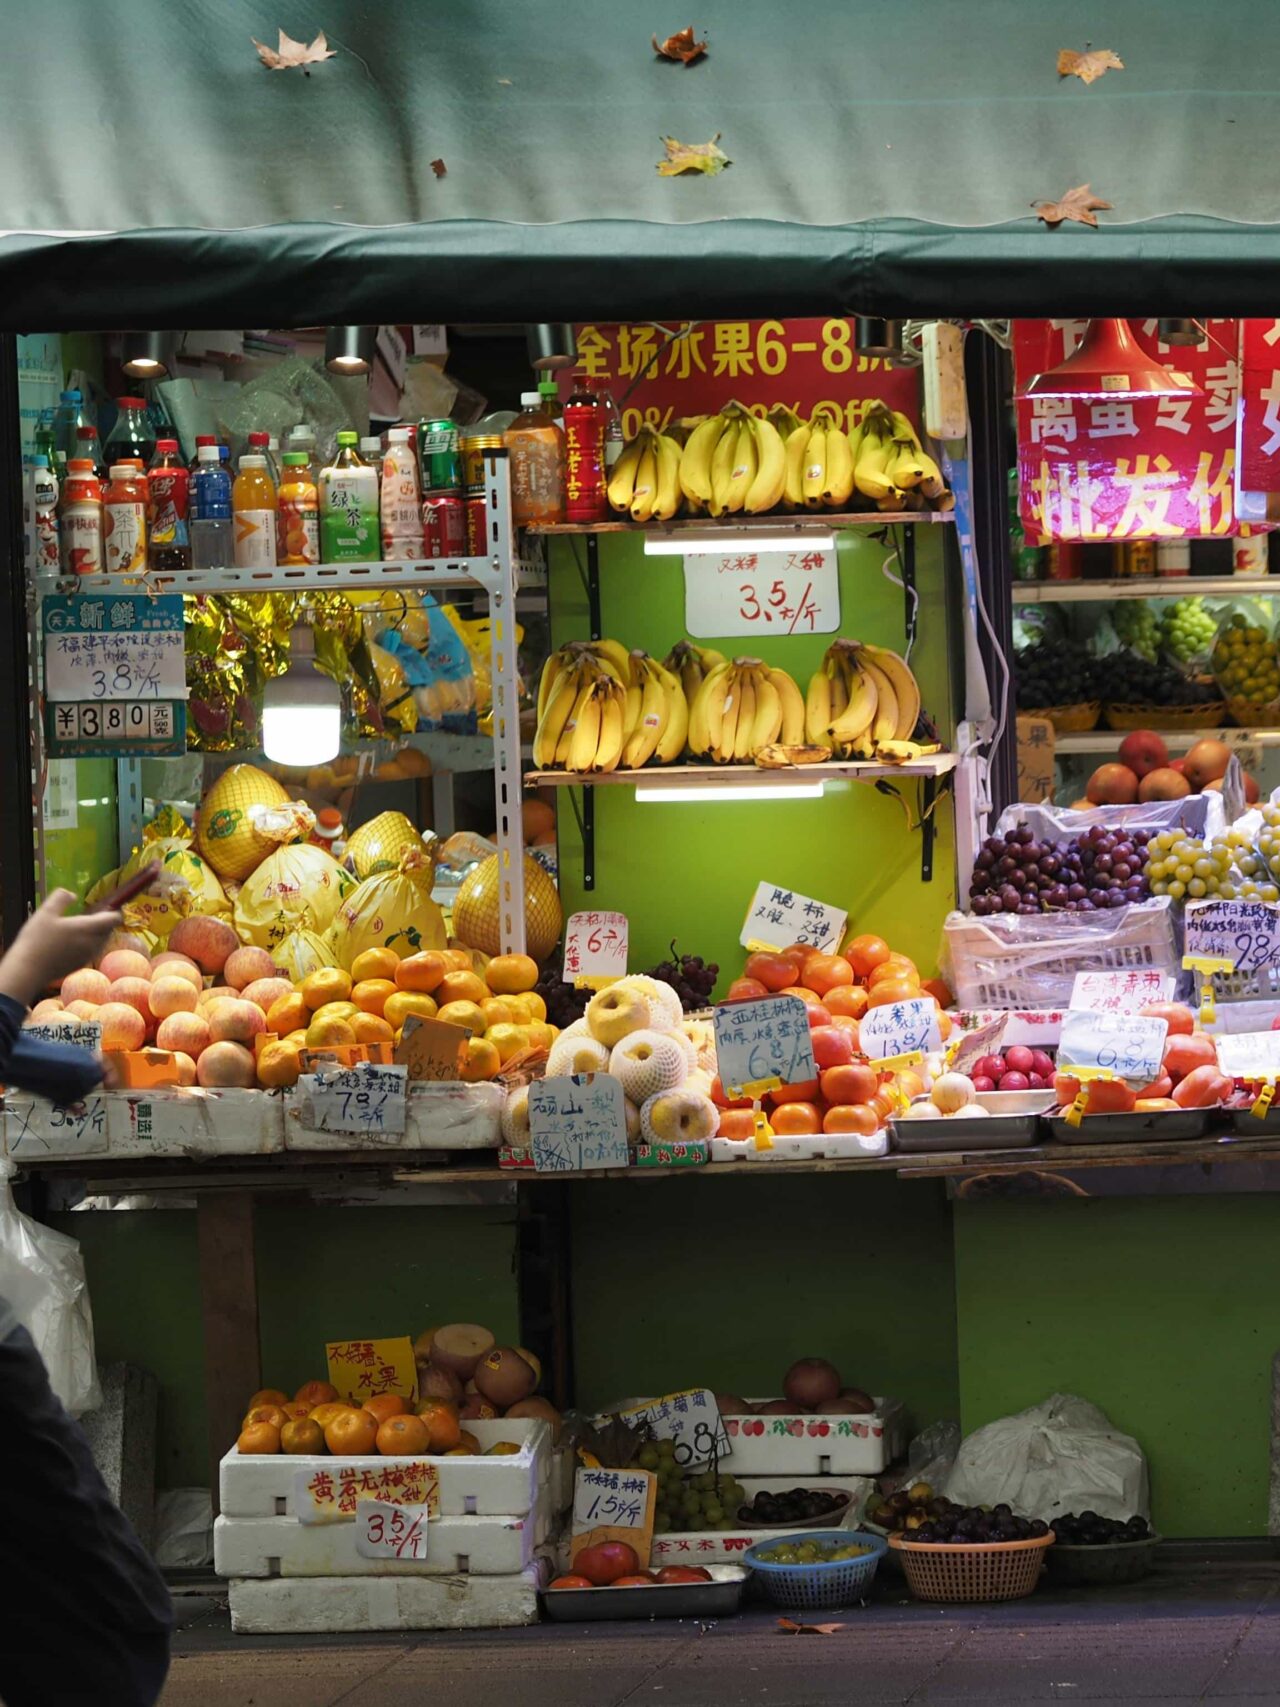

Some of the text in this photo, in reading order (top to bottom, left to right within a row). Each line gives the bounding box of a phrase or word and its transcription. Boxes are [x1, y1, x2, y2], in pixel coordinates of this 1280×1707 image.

[331, 490, 360, 528] 绿茶
[1031, 449, 1240, 543] 批发价
[784, 551, 825, 571] 又甜
[79, 601, 136, 630] 新鲜
[358, 1365, 404, 1390] 水果
